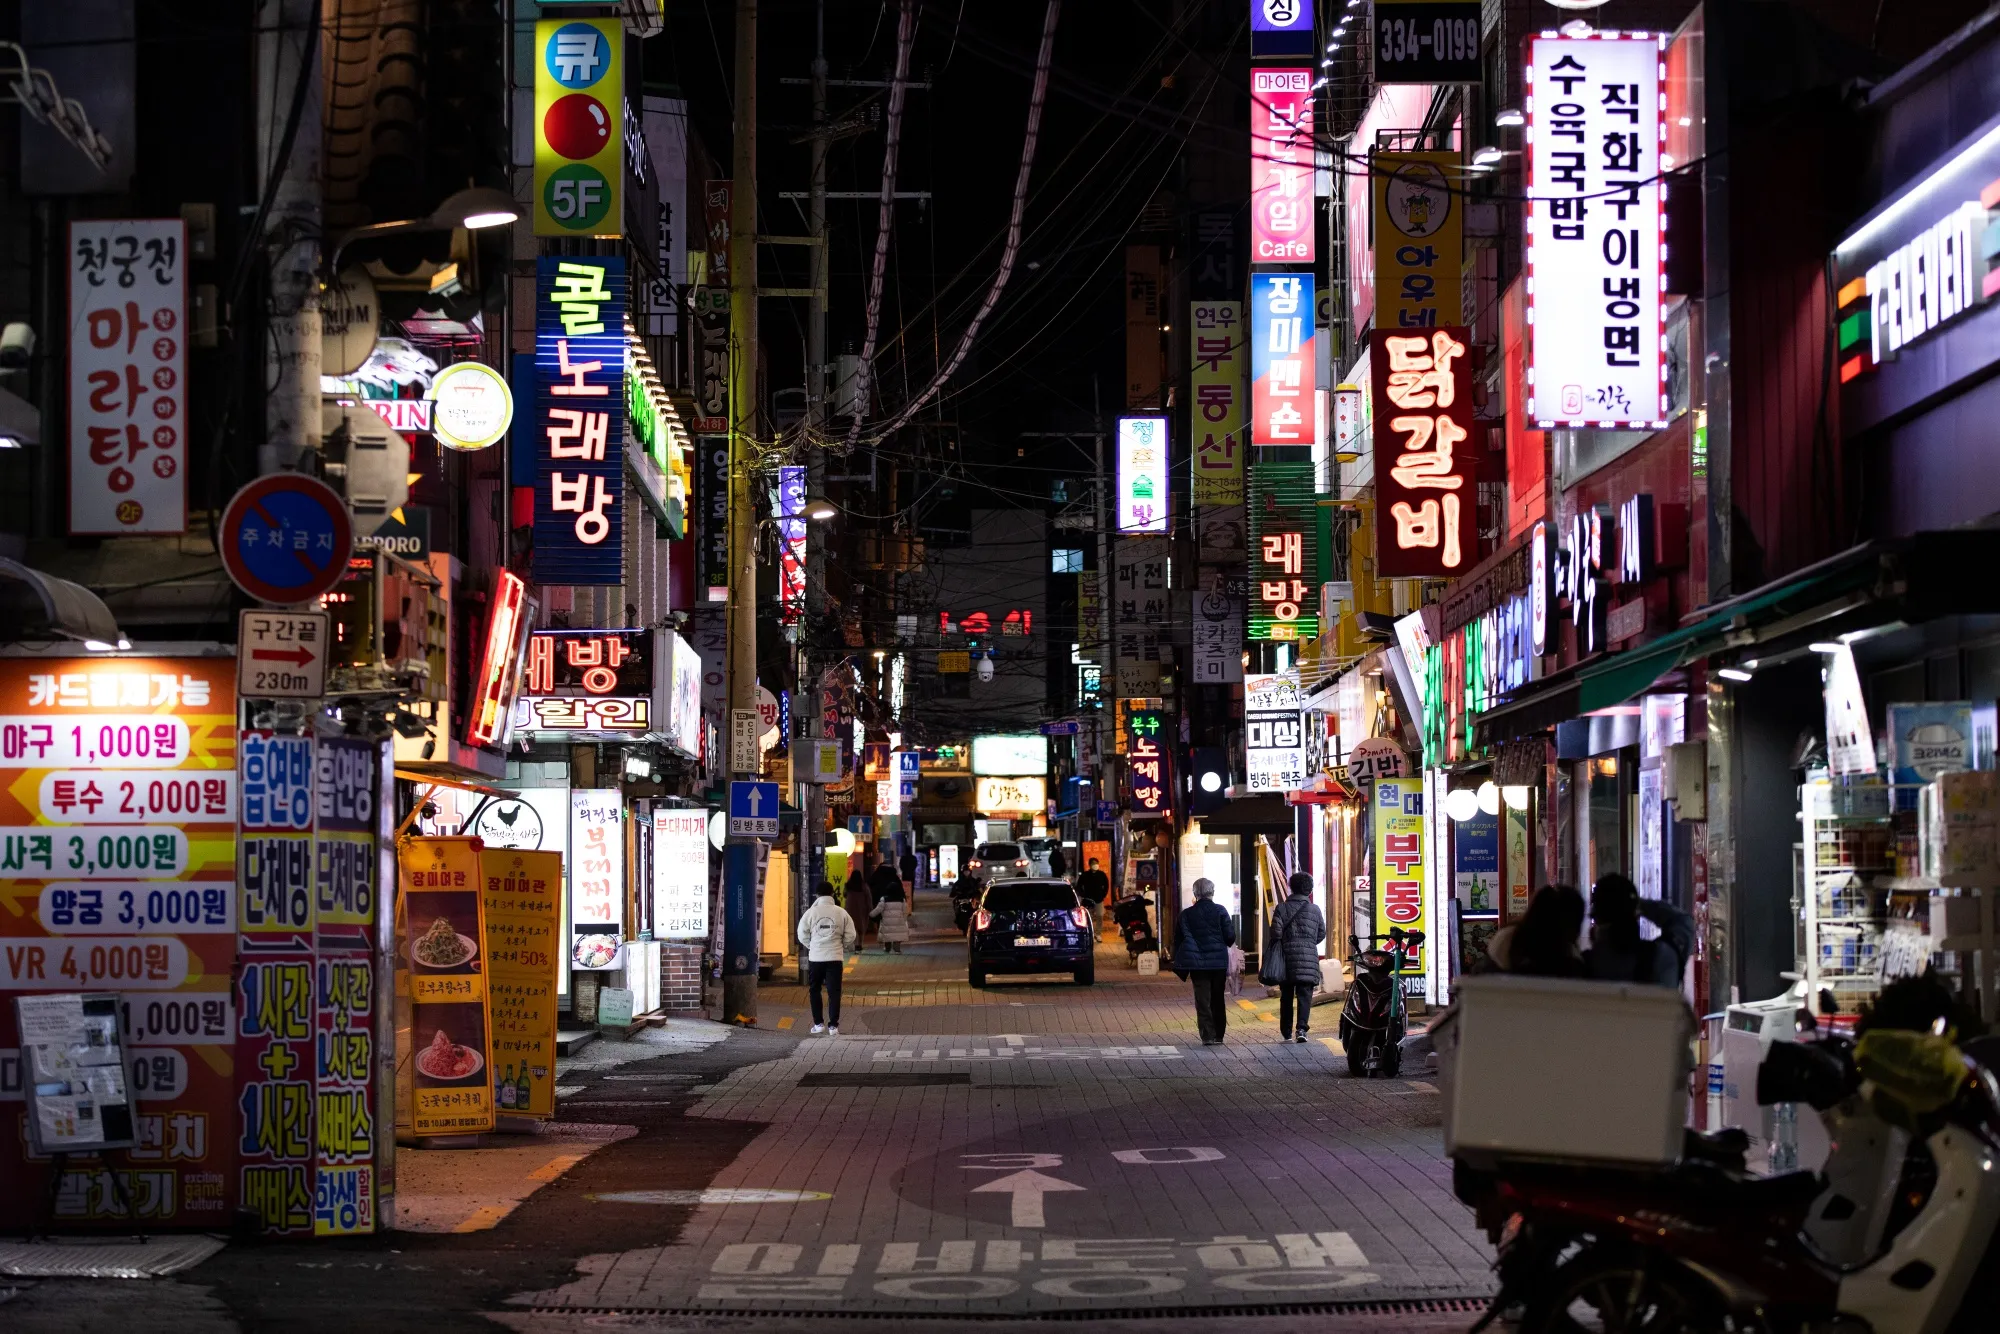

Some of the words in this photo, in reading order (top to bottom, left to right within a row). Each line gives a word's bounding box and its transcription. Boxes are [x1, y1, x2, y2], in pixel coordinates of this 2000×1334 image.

[555, 33, 599, 80] 큐
[1381, 19, 1478, 62] 334-0199
[1258, 75, 1306, 90] 마이턴
[1549, 54, 1588, 241] 수육국밥
[552, 179, 602, 219] 5F
[1601, 84, 1643, 367] 직화구이냉면
[77, 236, 176, 288] 천궁전
[1197, 213, 1234, 300] 독서
[1259, 241, 1308, 257] Cafe
[551, 262, 612, 335] 콜
[1396, 245, 1439, 327] 아우네
[1195, 307, 1237, 328] 연우
[87, 301, 149, 493] 마라탕
[1196, 336, 1237, 469] 부동산
[547, 340, 613, 544] 노래방
[699, 420, 723, 430] 지하
[1386, 331, 1467, 567] 닭갈비
[1132, 421, 1154, 528] 청춘술방
[1194, 477, 1241, 487] 312-1849
[120, 502, 142, 522] 2F
[241, 528, 333, 550] 주차금지
[710, 573, 724, 584] 3F
[1120, 563, 1163, 589] 파전
[253, 620, 317, 641] 구간끝
[1206, 624, 1227, 680] 카츠미
[256, 672, 308, 690] 230m
[534, 699, 650, 728] 할인
[3, 724, 53, 758] 야구
[72, 724, 176, 762] 1,000원
[1247, 721, 1299, 747] 대상
[1132, 738, 1162, 808] 노래방
[1352, 755, 1402, 786] 김밥
[52, 780, 104, 815] 투수
[119, 779, 227, 819] 2,000원
[580, 807, 619, 824] 의정부
[1378, 783, 1424, 816] 현대
[656, 816, 705, 836] 부대찌개
[732, 819, 777, 832] 일방통행
[2, 835, 53, 870] 사격
[68, 835, 177, 874] 3,000원
[582, 826, 612, 922] 부대찌개
[245, 839, 310, 927] 단체방
[318, 841, 373, 915] 단체방
[413, 871, 466, 887] 장미여관
[488, 877, 546, 893] 장미여관
[52, 890, 103, 926] 양궁
[118, 889, 226, 929] 3,000원
[669, 919, 702, 931] 김치전
[6, 946, 46, 979] VR
[60, 944, 169, 984] 4,000원
[520, 951, 548, 966] 50%
[242, 965, 310, 1038] 1시간
[319, 963, 370, 1010] 1시간
[319, 1032, 370, 1080] 1시간
[872, 1045, 1185, 1061] 일방통행
[242, 1084, 310, 1158] 1시간
[185, 1172, 224, 1184] exciting
[185, 1184, 224, 1197] game
[358, 1168, 371, 1227] 할인
[185, 1199, 224, 1210] culture
[316, 1169, 356, 1230] 학생
[700, 1231, 1381, 1299] 일방통행
